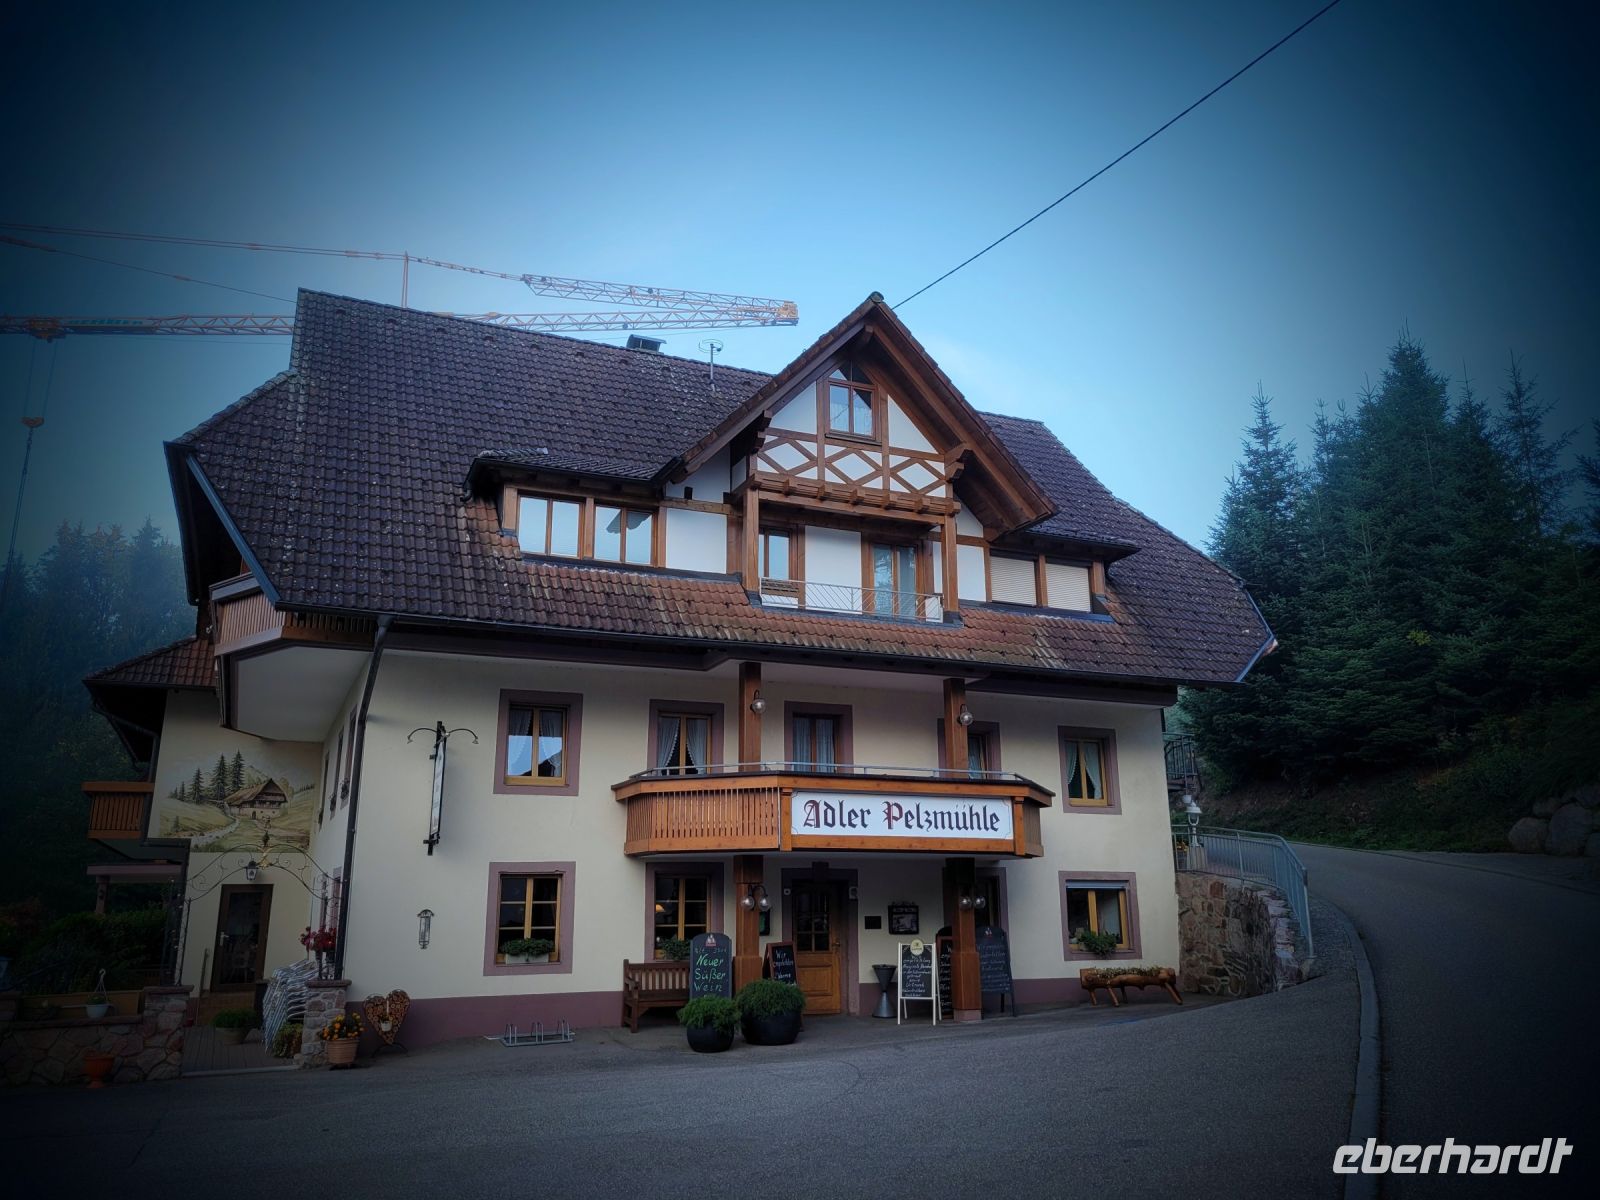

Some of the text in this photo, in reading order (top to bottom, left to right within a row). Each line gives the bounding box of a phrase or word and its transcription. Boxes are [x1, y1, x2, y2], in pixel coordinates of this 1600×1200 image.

[803, 799, 1000, 832] Adler Pelzmühle
[696, 953, 724, 966] Neuer
[694, 967, 726, 983] Süßer
[693, 981, 722, 992] Wein
